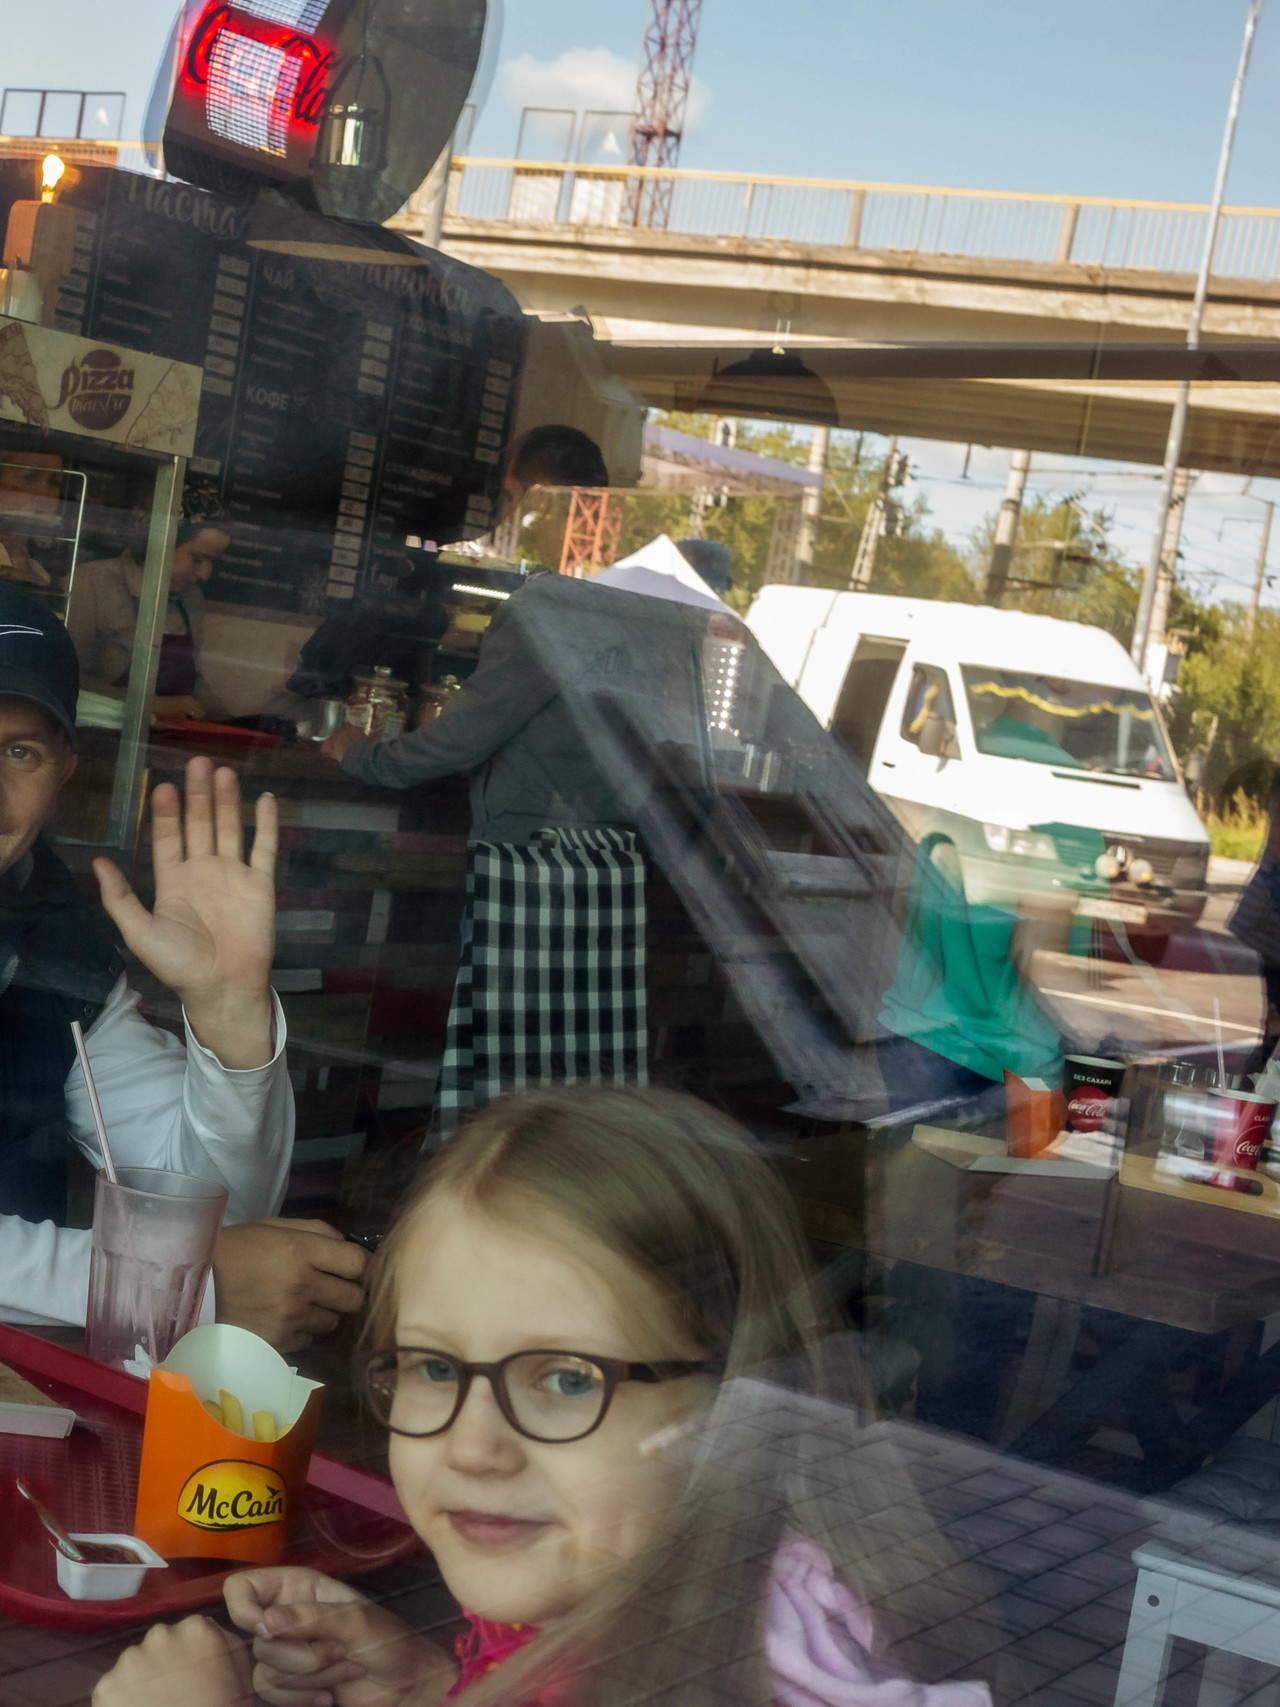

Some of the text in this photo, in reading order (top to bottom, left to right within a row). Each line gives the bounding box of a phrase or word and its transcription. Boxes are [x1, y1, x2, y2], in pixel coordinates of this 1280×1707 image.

[245, 383, 290, 412] КОФЕ
[1073, 1073, 1112, 1085] БЕЗ САХАРА
[186, 1483, 283, 1520] McCain
